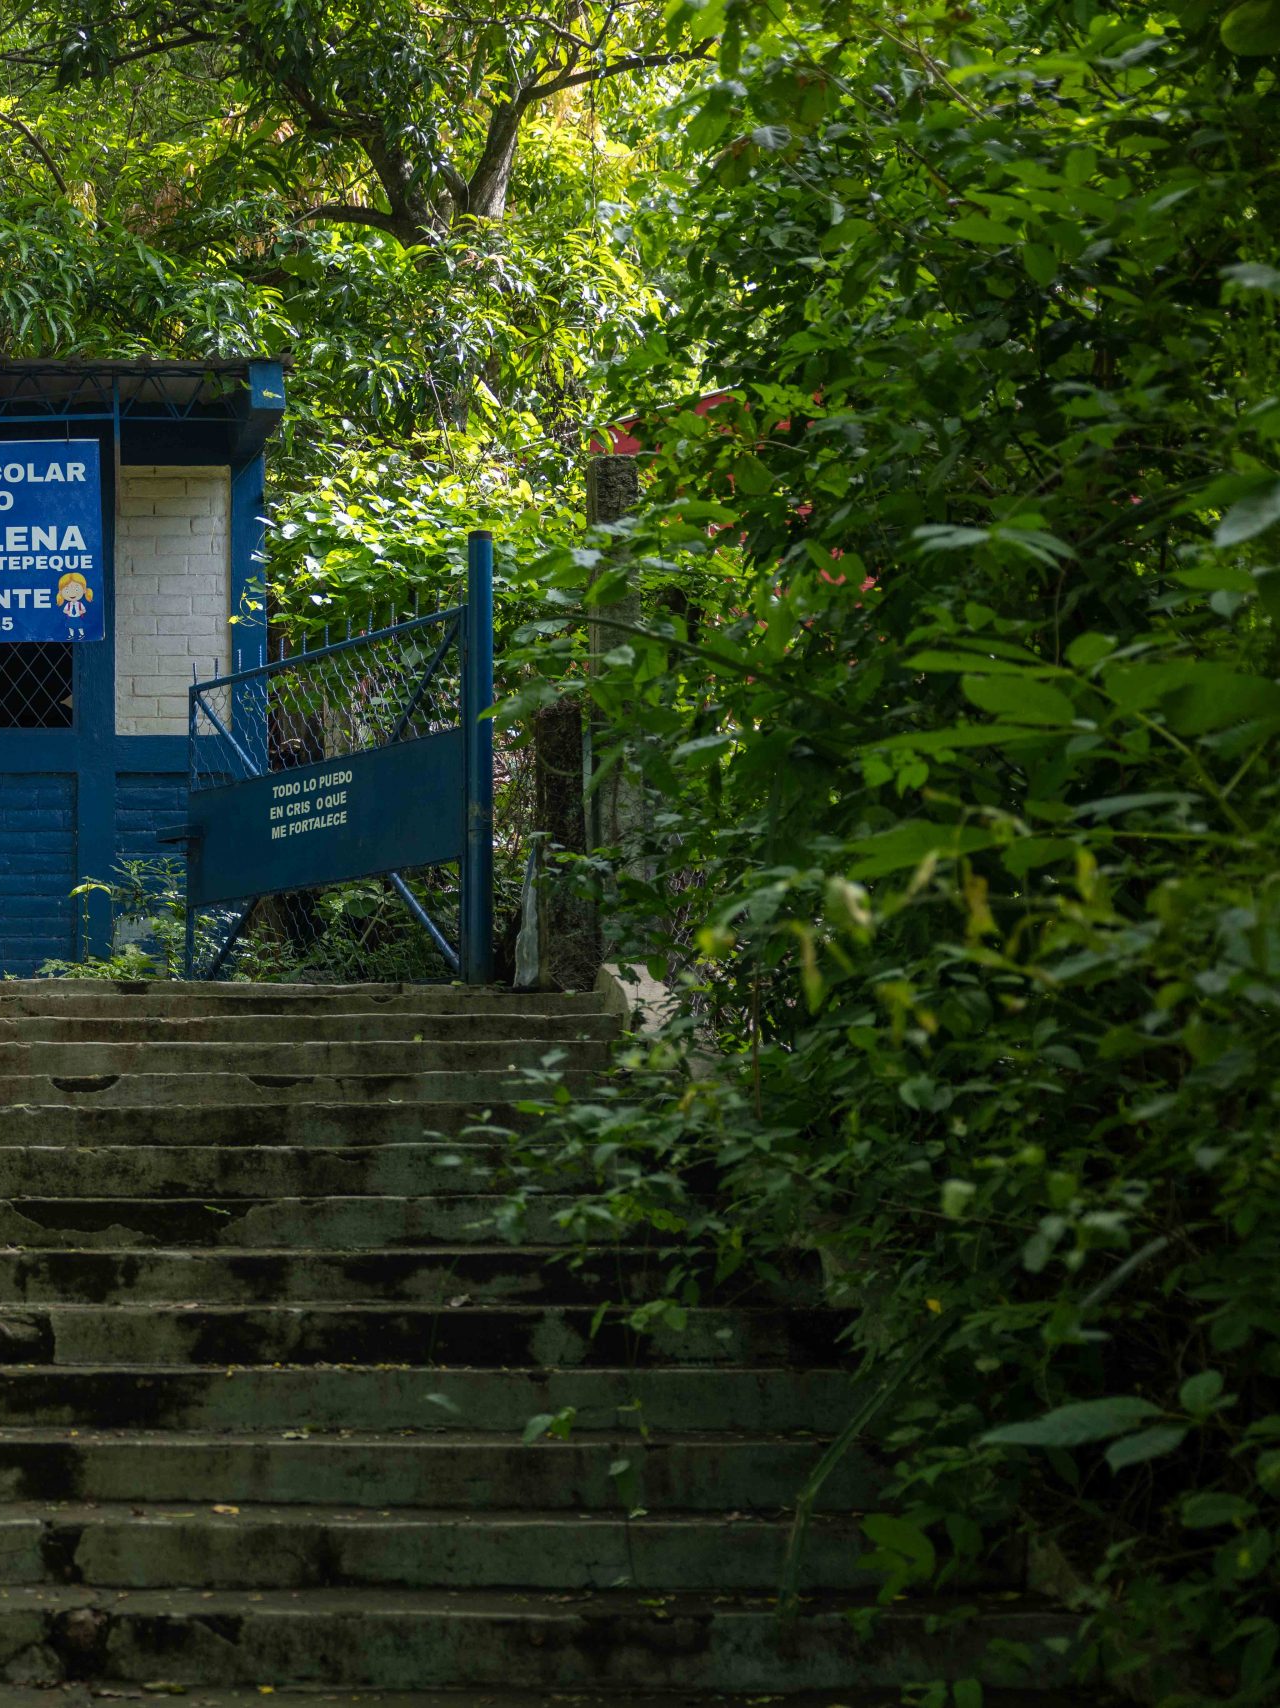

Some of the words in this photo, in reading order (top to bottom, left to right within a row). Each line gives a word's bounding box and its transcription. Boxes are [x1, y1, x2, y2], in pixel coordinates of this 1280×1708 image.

[272, 781, 301, 799] TODO
[303, 778, 317, 793] LO
[319, 770, 353, 789] PUEDO
[269, 805, 284, 820] EN
[324, 791, 347, 808] QUE
[271, 825, 287, 840] ME
[289, 811, 347, 836] FORTALECE
